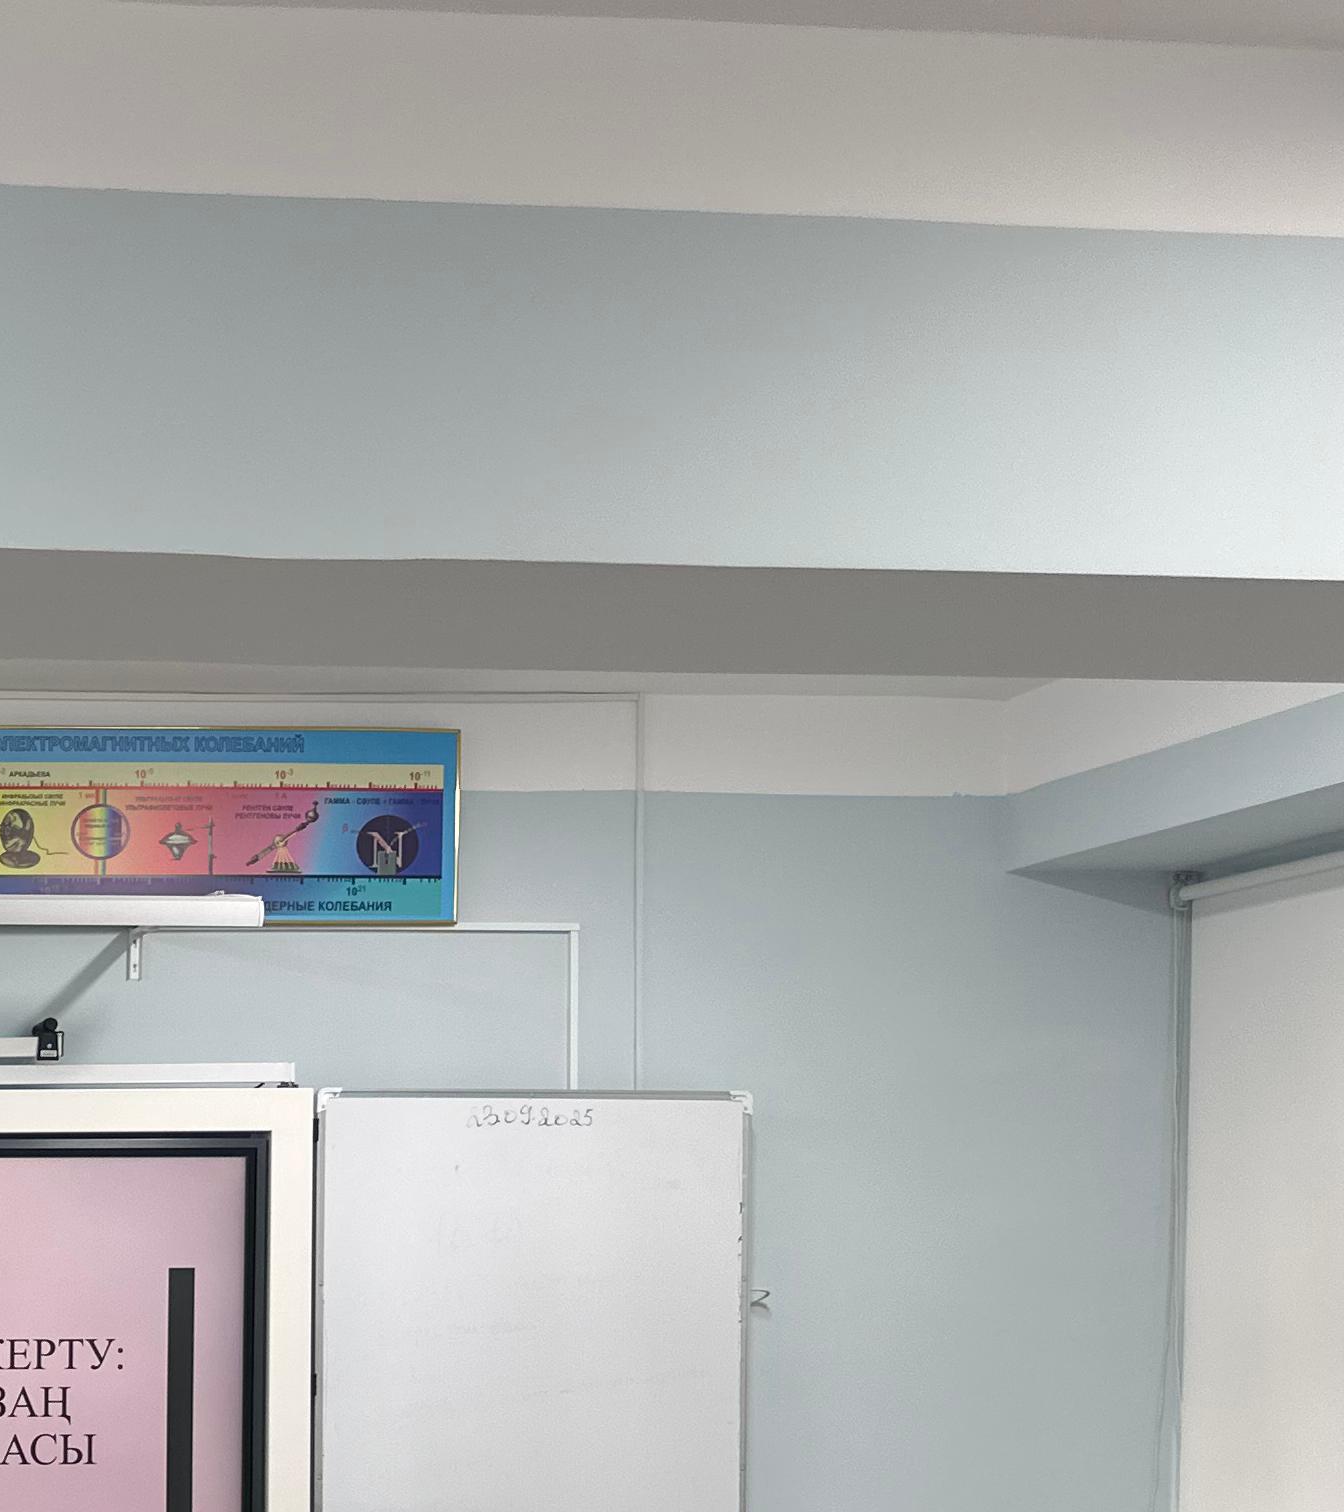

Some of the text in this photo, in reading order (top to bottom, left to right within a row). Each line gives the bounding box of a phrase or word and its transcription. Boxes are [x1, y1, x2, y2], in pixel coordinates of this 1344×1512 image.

[194, 733, 305, 753] КОЛЕБАНИЙ
[263, 901, 392, 912] ДЕРНЫЕ КОЛЕБАНИЯ
